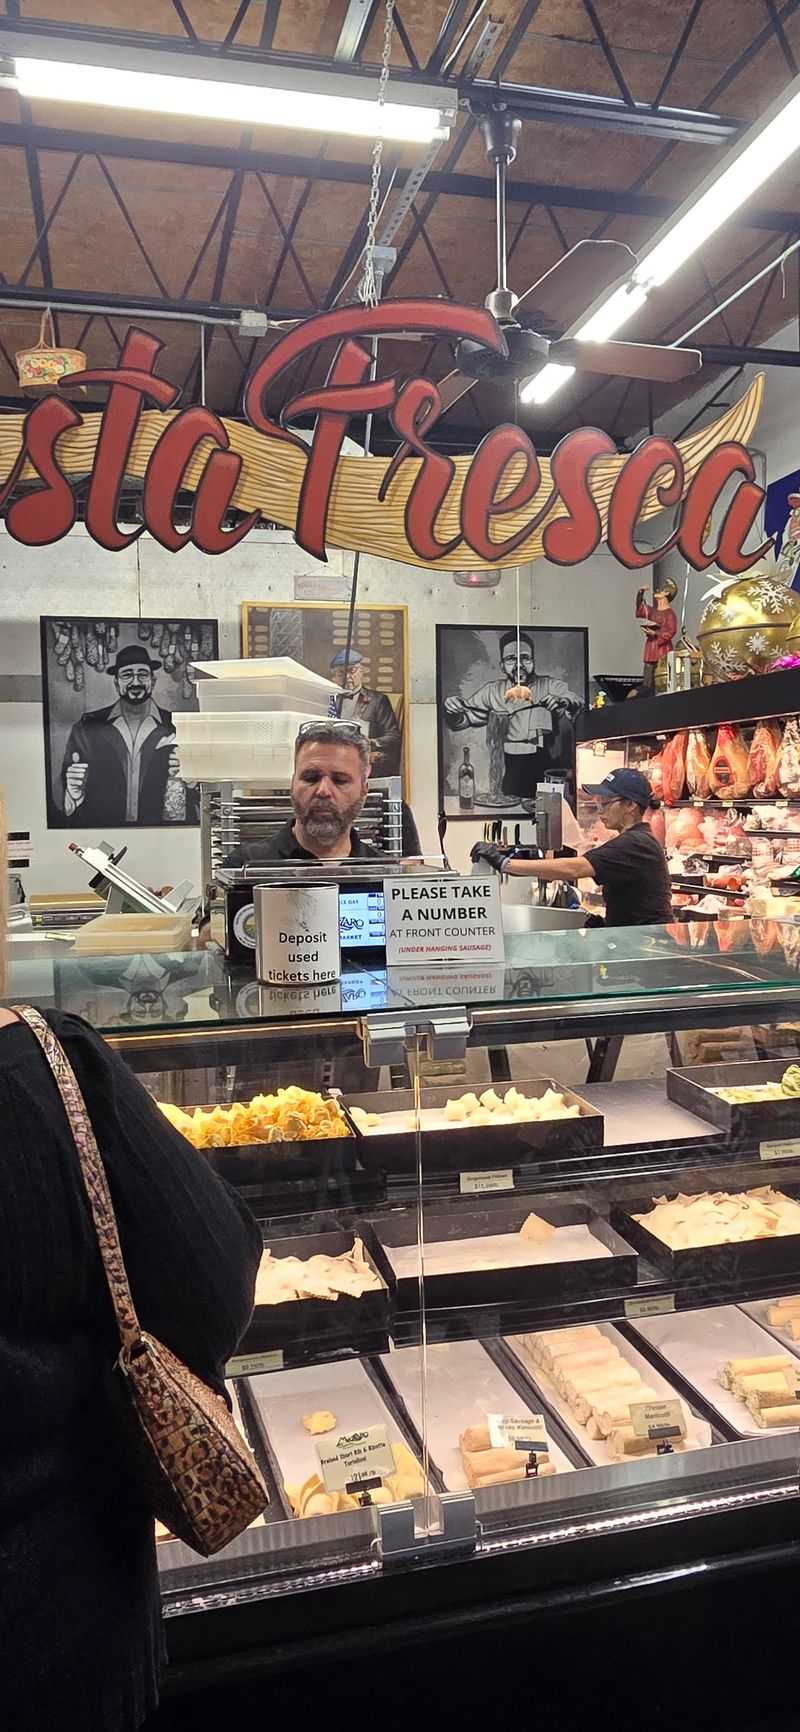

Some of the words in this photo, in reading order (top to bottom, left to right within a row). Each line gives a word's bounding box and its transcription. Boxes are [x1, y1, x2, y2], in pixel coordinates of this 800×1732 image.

[243, 298, 776, 576] Fresca
[391, 886, 448, 900] PLEASE
[450, 884, 492, 899] TAKE
[401, 908, 415, 921] A
[417, 906, 488, 921] NUMBER
[278, 931, 328, 946] Deposit
[389, 928, 403, 938] AT
[405, 927, 442, 937] FRONT
[444, 926, 496, 937] COUNTER
[288, 951, 319, 963] used
[268, 970, 310, 982] tickets
[312, 969, 336, 981] here
